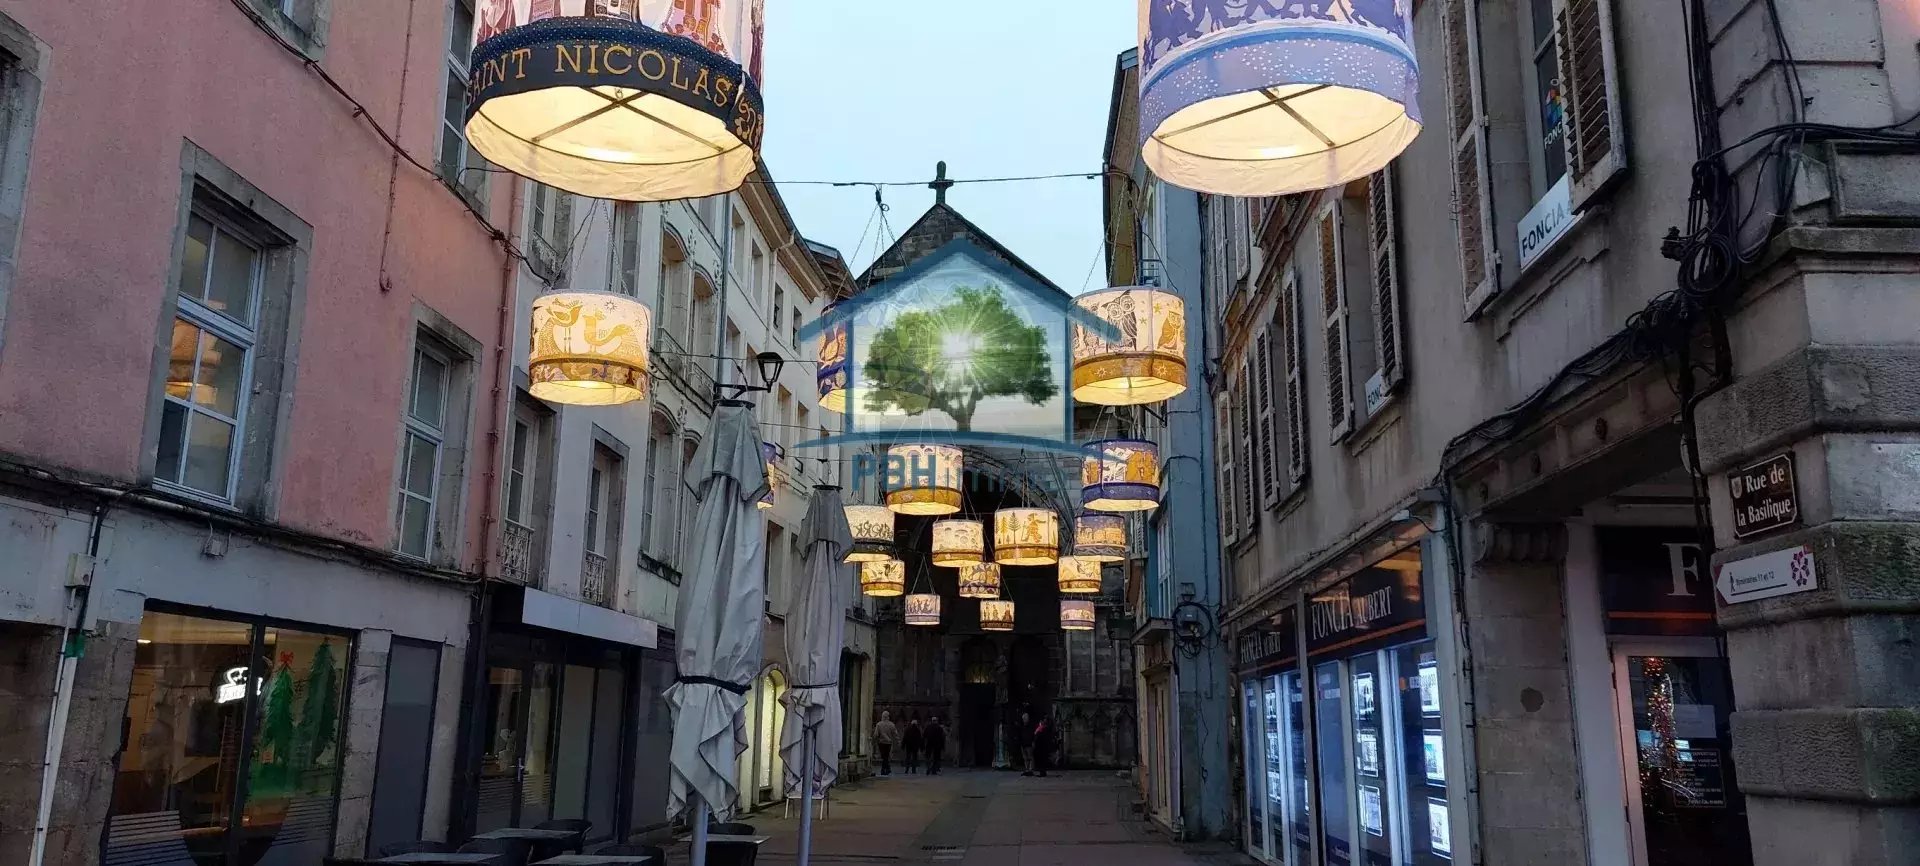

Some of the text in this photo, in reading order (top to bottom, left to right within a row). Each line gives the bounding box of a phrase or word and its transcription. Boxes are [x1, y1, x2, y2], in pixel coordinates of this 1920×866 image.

[554, 44, 732, 107] NICOLAS
[1521, 202, 1565, 258] FONCIA
[1746, 463, 1785, 493] Rue de
[1737, 497, 1792, 527] la Basilique
[1312, 589, 1354, 640] FONCIA
